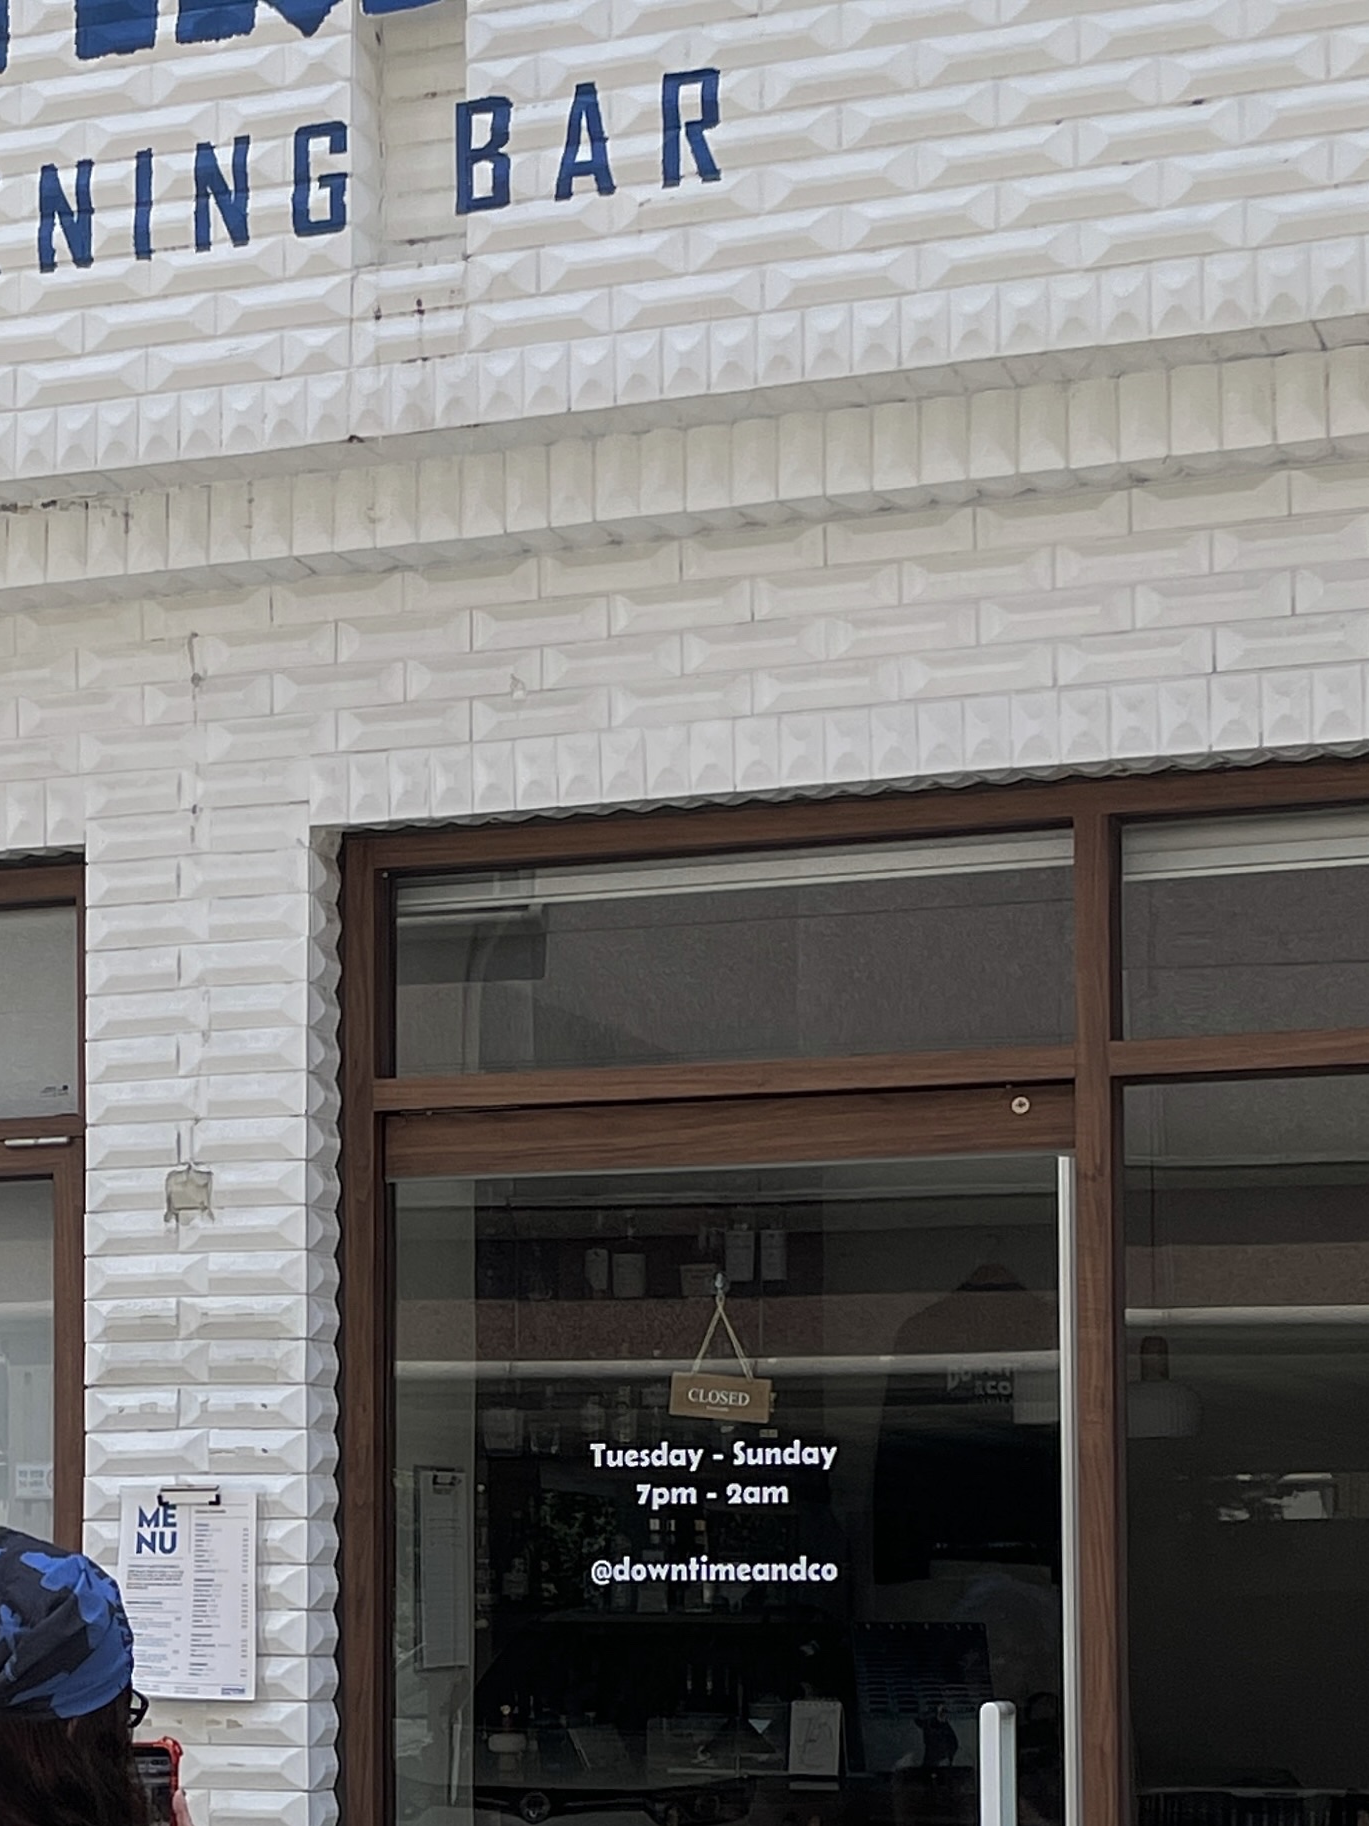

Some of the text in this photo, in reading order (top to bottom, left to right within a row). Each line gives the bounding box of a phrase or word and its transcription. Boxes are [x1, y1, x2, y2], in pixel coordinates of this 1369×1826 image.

[455, 67, 721, 216] BAR
[687, 1387, 751, 1407] CLOSED
[589, 1439, 838, 1472] Tuesday - Sunday
[636, 1483, 698, 1510] 7pm
[726, 1483, 789, 1504] 2am
[137, 1504, 177, 1528] ME
[136, 1531, 177, 1555] NU
[590, 1555, 839, 1586] @downtimeandco
